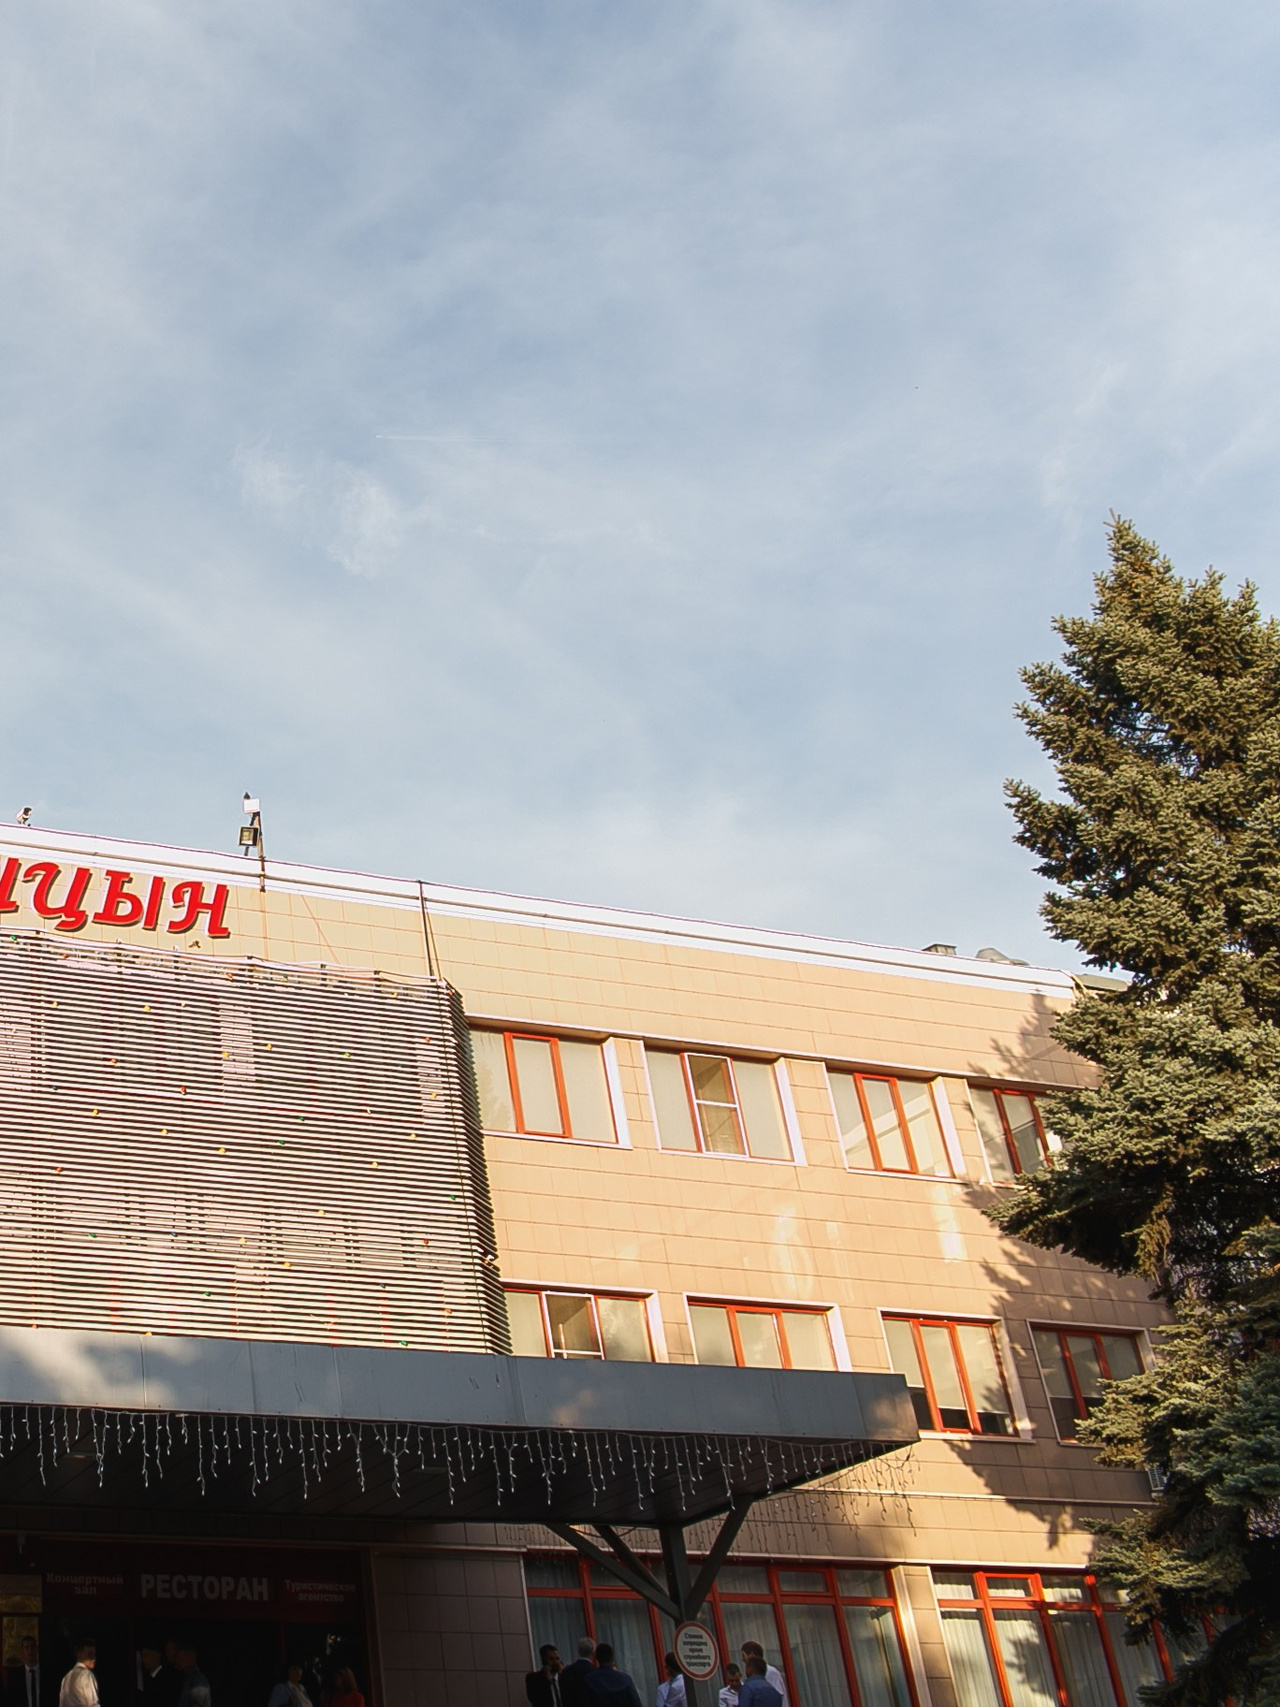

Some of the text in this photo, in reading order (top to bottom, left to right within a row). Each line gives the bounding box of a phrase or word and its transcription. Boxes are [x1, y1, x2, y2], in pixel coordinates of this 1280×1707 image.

[46, 1571, 124, 1586] Концертный
[284, 1579, 357, 1592] Туристическое
[74, 1586, 97, 1595] зал
[140, 1574, 268, 1601] РЕСТОРАН
